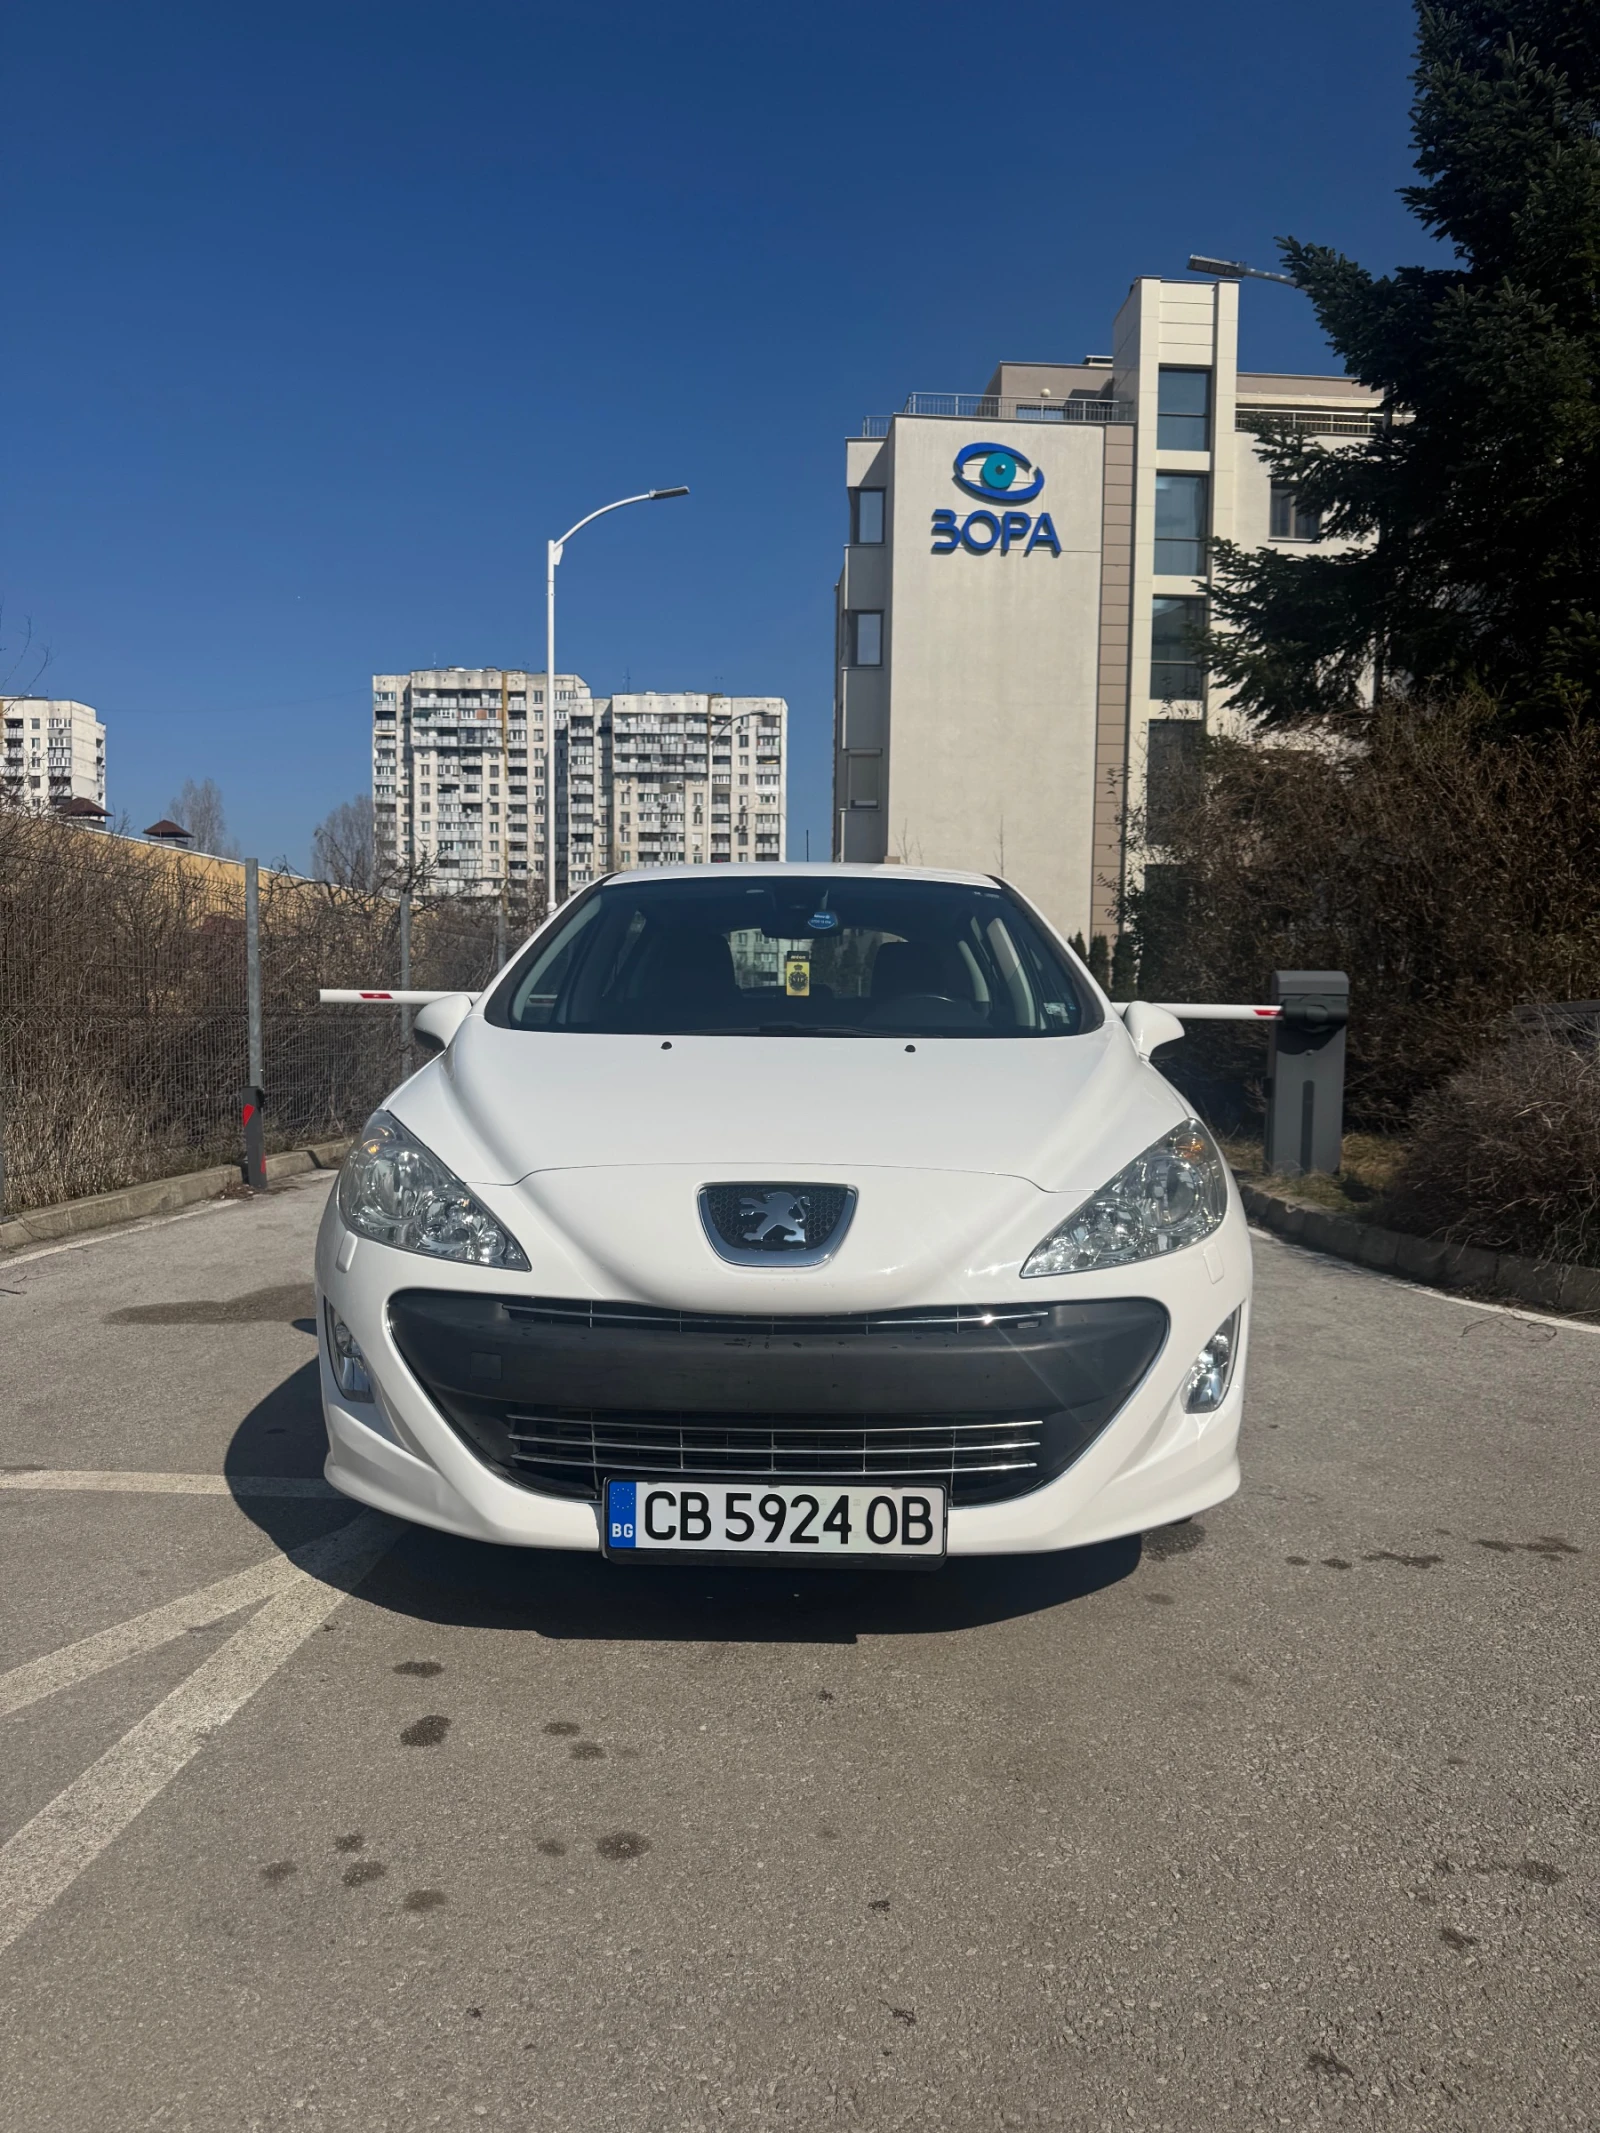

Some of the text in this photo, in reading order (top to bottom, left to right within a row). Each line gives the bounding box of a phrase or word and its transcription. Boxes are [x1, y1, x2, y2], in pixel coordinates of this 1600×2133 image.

[932, 509, 1062, 554] ЗОРА
[612, 1522, 634, 1538] BG
[644, 1490, 934, 1546] CB 5924 OB
